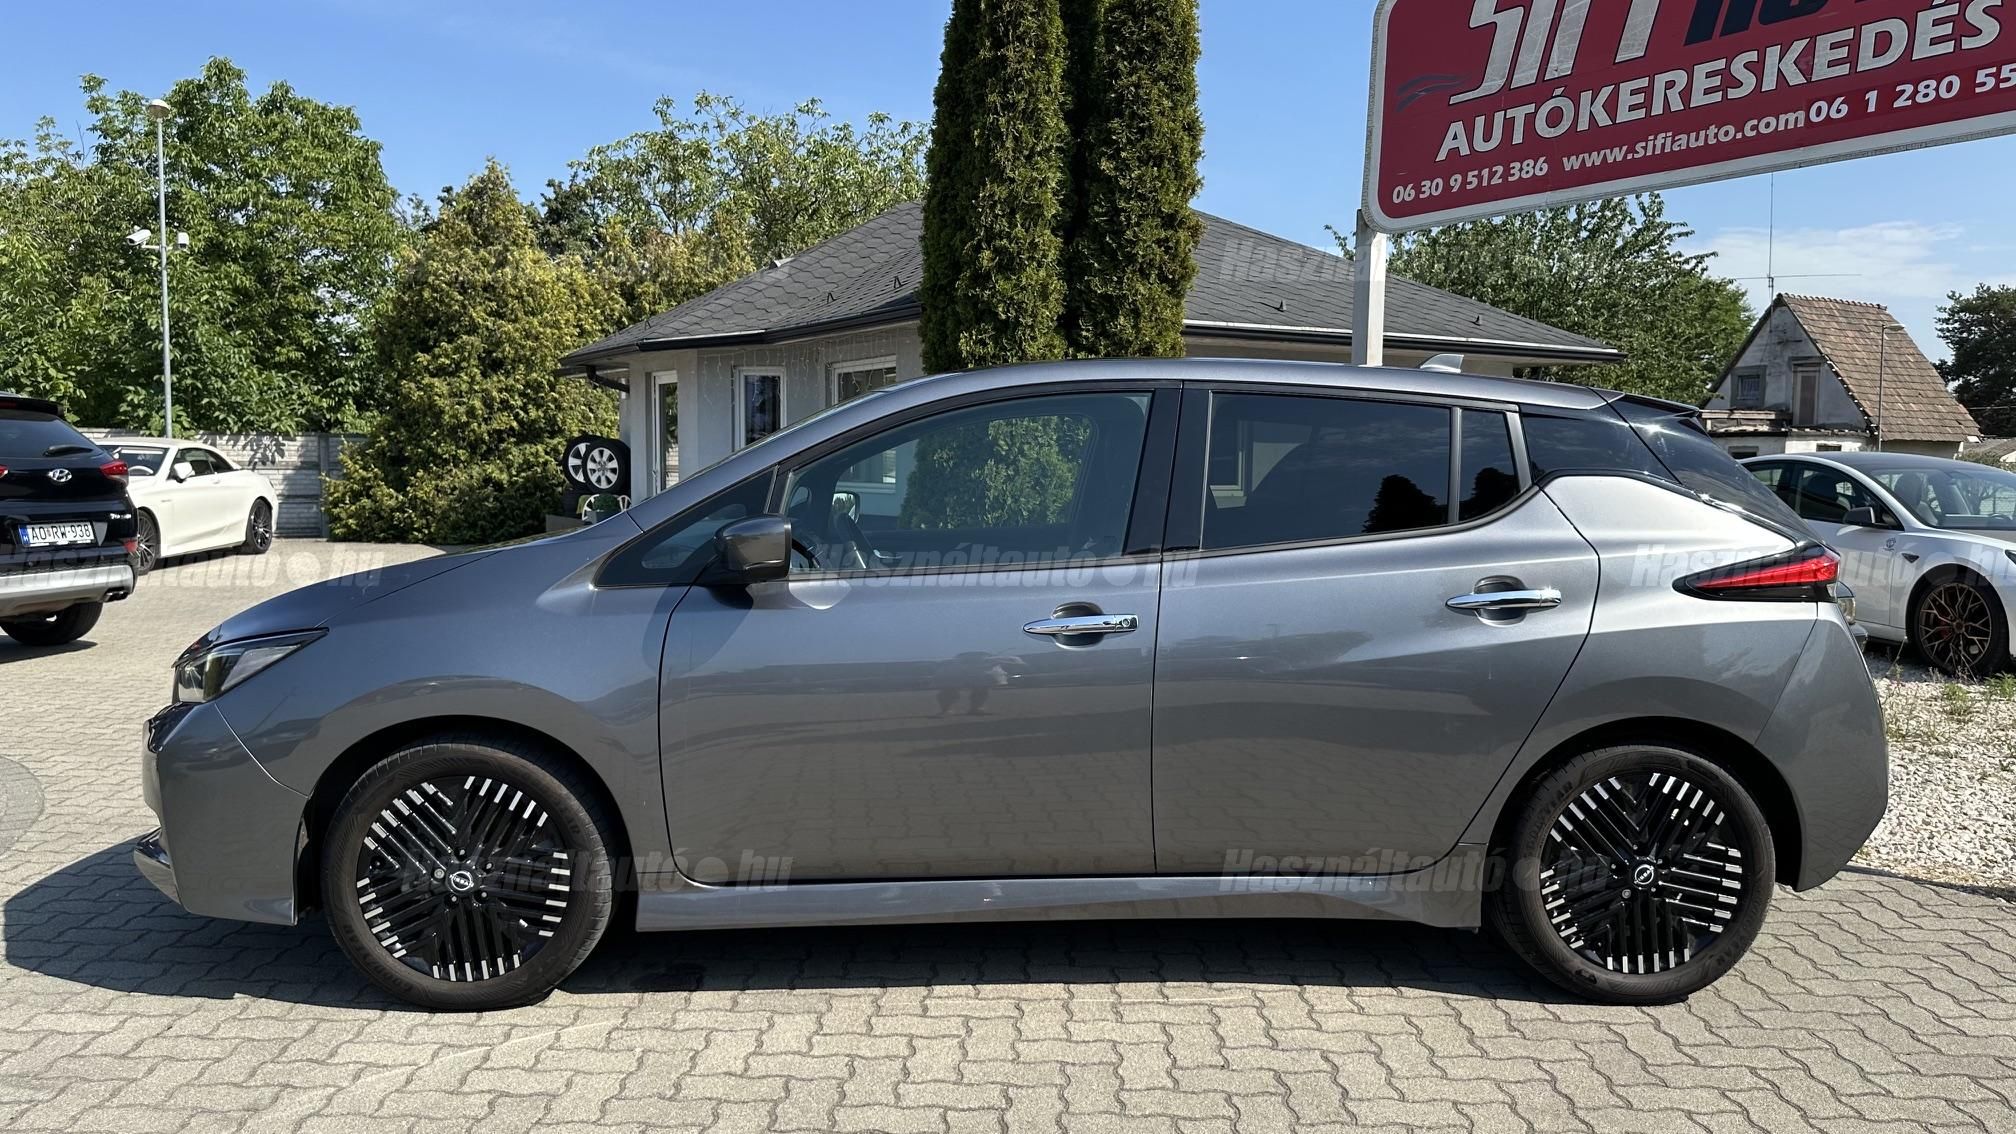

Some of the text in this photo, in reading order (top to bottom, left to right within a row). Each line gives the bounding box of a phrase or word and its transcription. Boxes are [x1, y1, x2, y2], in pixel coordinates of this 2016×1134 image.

[1392, 183, 1416, 204] 06
[1419, 177, 1444, 199] 30
[1507, 156, 1549, 182] 386
[1561, 109, 1806, 171] www.sifiauto.com
[1808, 96, 1849, 123] 06
[1864, 89, 1878, 113] 1
[1892, 74, 1961, 108] 280
[1435, 0, 2003, 162] AUTÓKERESKEDÉS
